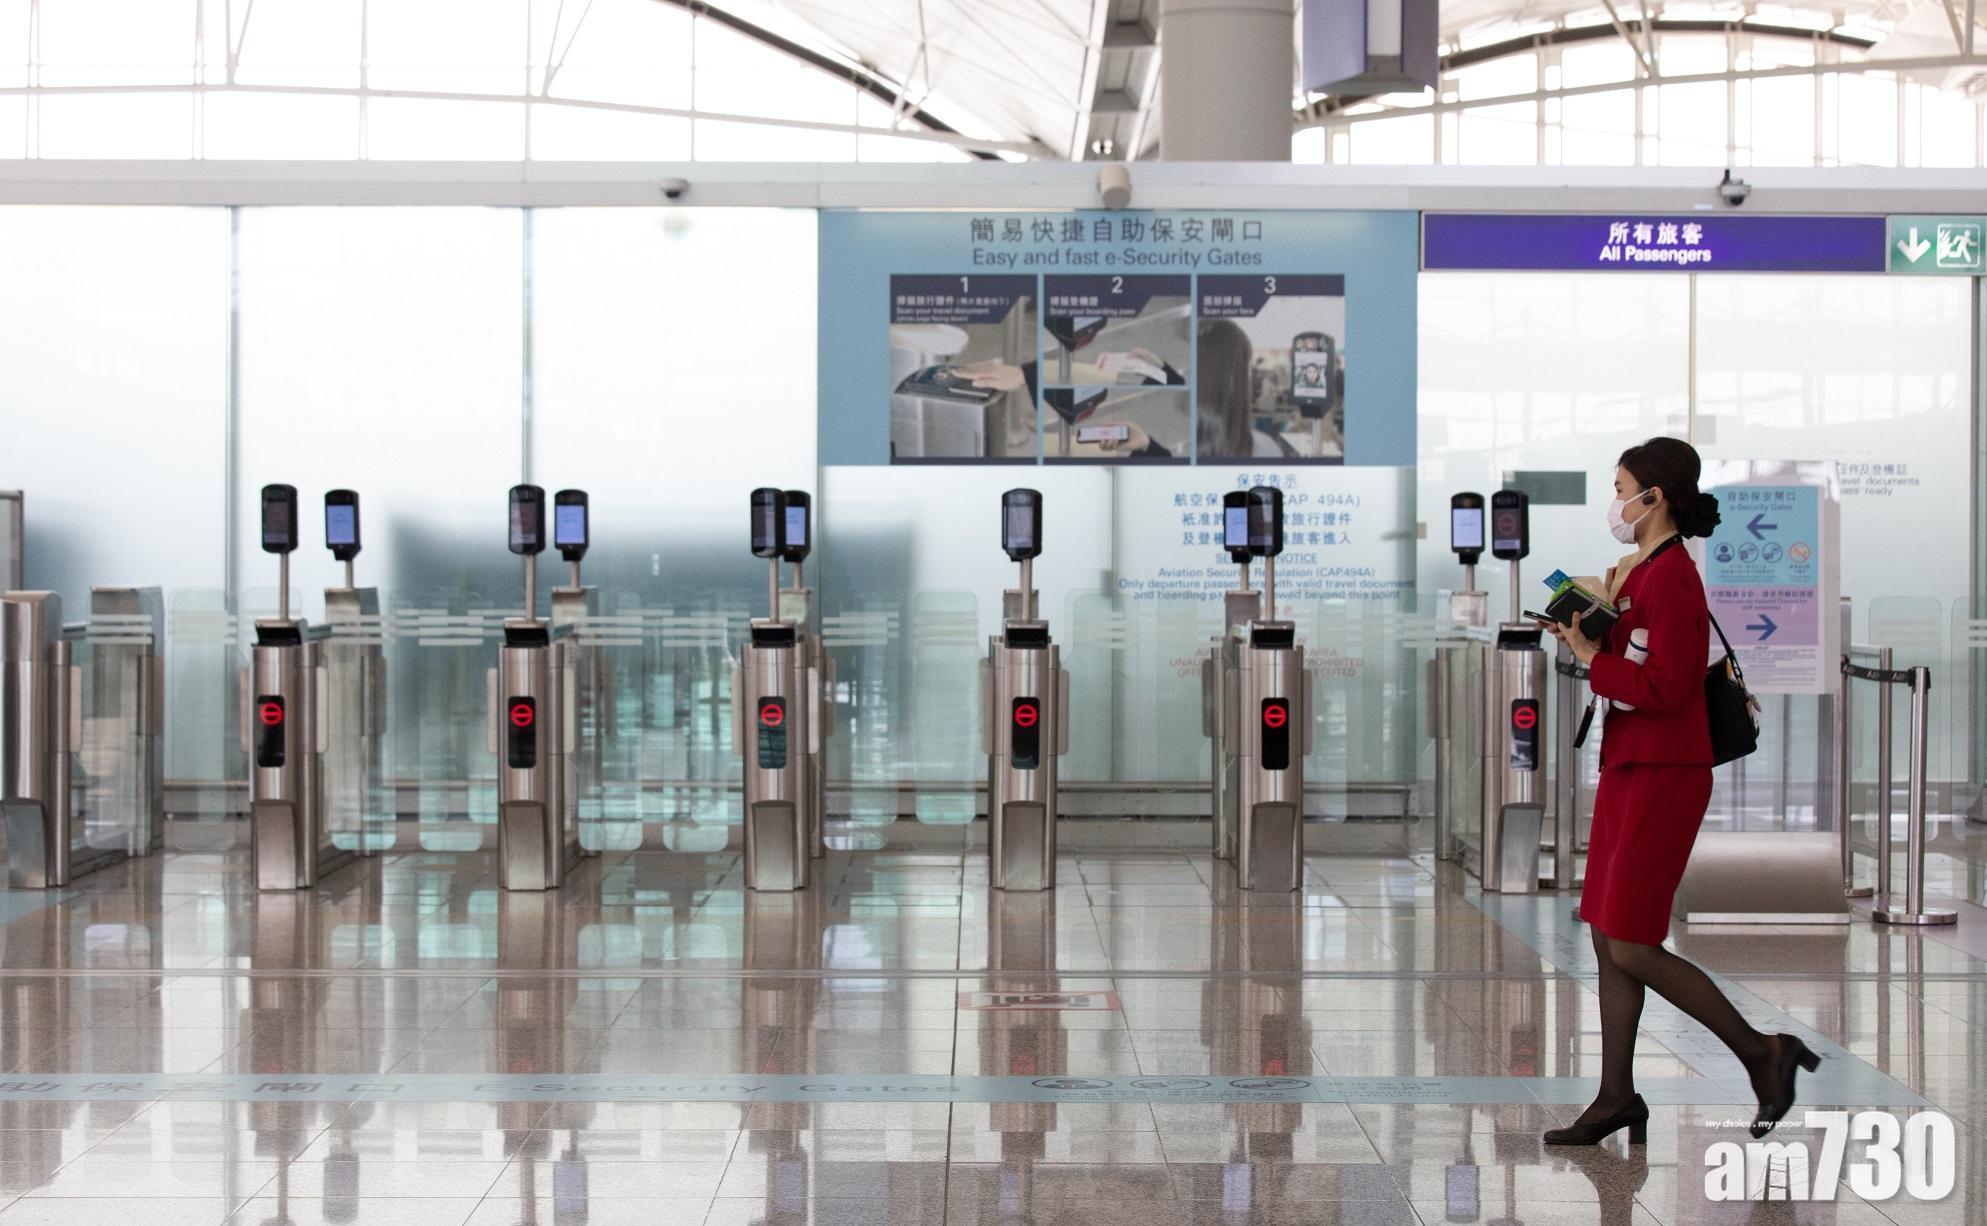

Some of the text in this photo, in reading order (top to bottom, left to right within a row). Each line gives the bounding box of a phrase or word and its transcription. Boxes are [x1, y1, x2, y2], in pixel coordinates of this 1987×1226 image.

[970, 217, 1262, 243] 簡易快捷自助保安閘口
[1608, 222, 1703, 245] 所有旅客
[973, 247, 1262, 269] Easy and fast e-Security Gates
[1599, 245, 1712, 265] All Passengers
[961, 276, 969, 294] 1
[1112, 276, 1123, 294] 2
[1264, 276, 1276, 294] 3
[1237, 473, 1298, 488] 保安告示
[1865, 487, 1893, 496] ready
[1277, 553, 1318, 564] NOTICE
[1158, 567, 1203, 577] Aviation
[1255, 567, 1312, 578] Reulation
[1119, 579, 1144, 589] Only
[1147, 579, 1202, 590] departure
[1204, 581, 1265, 590] passeners
[1296, 579, 1322, 588] valid
[1325, 579, 1357, 588] travel
[1133, 591, 1155, 600] and
[1157, 591, 1207, 601] boarding
[1304, 591, 1346, 601] beyond
[1348, 591, 1369, 600] this
[1370, 591, 1401, 601] point
